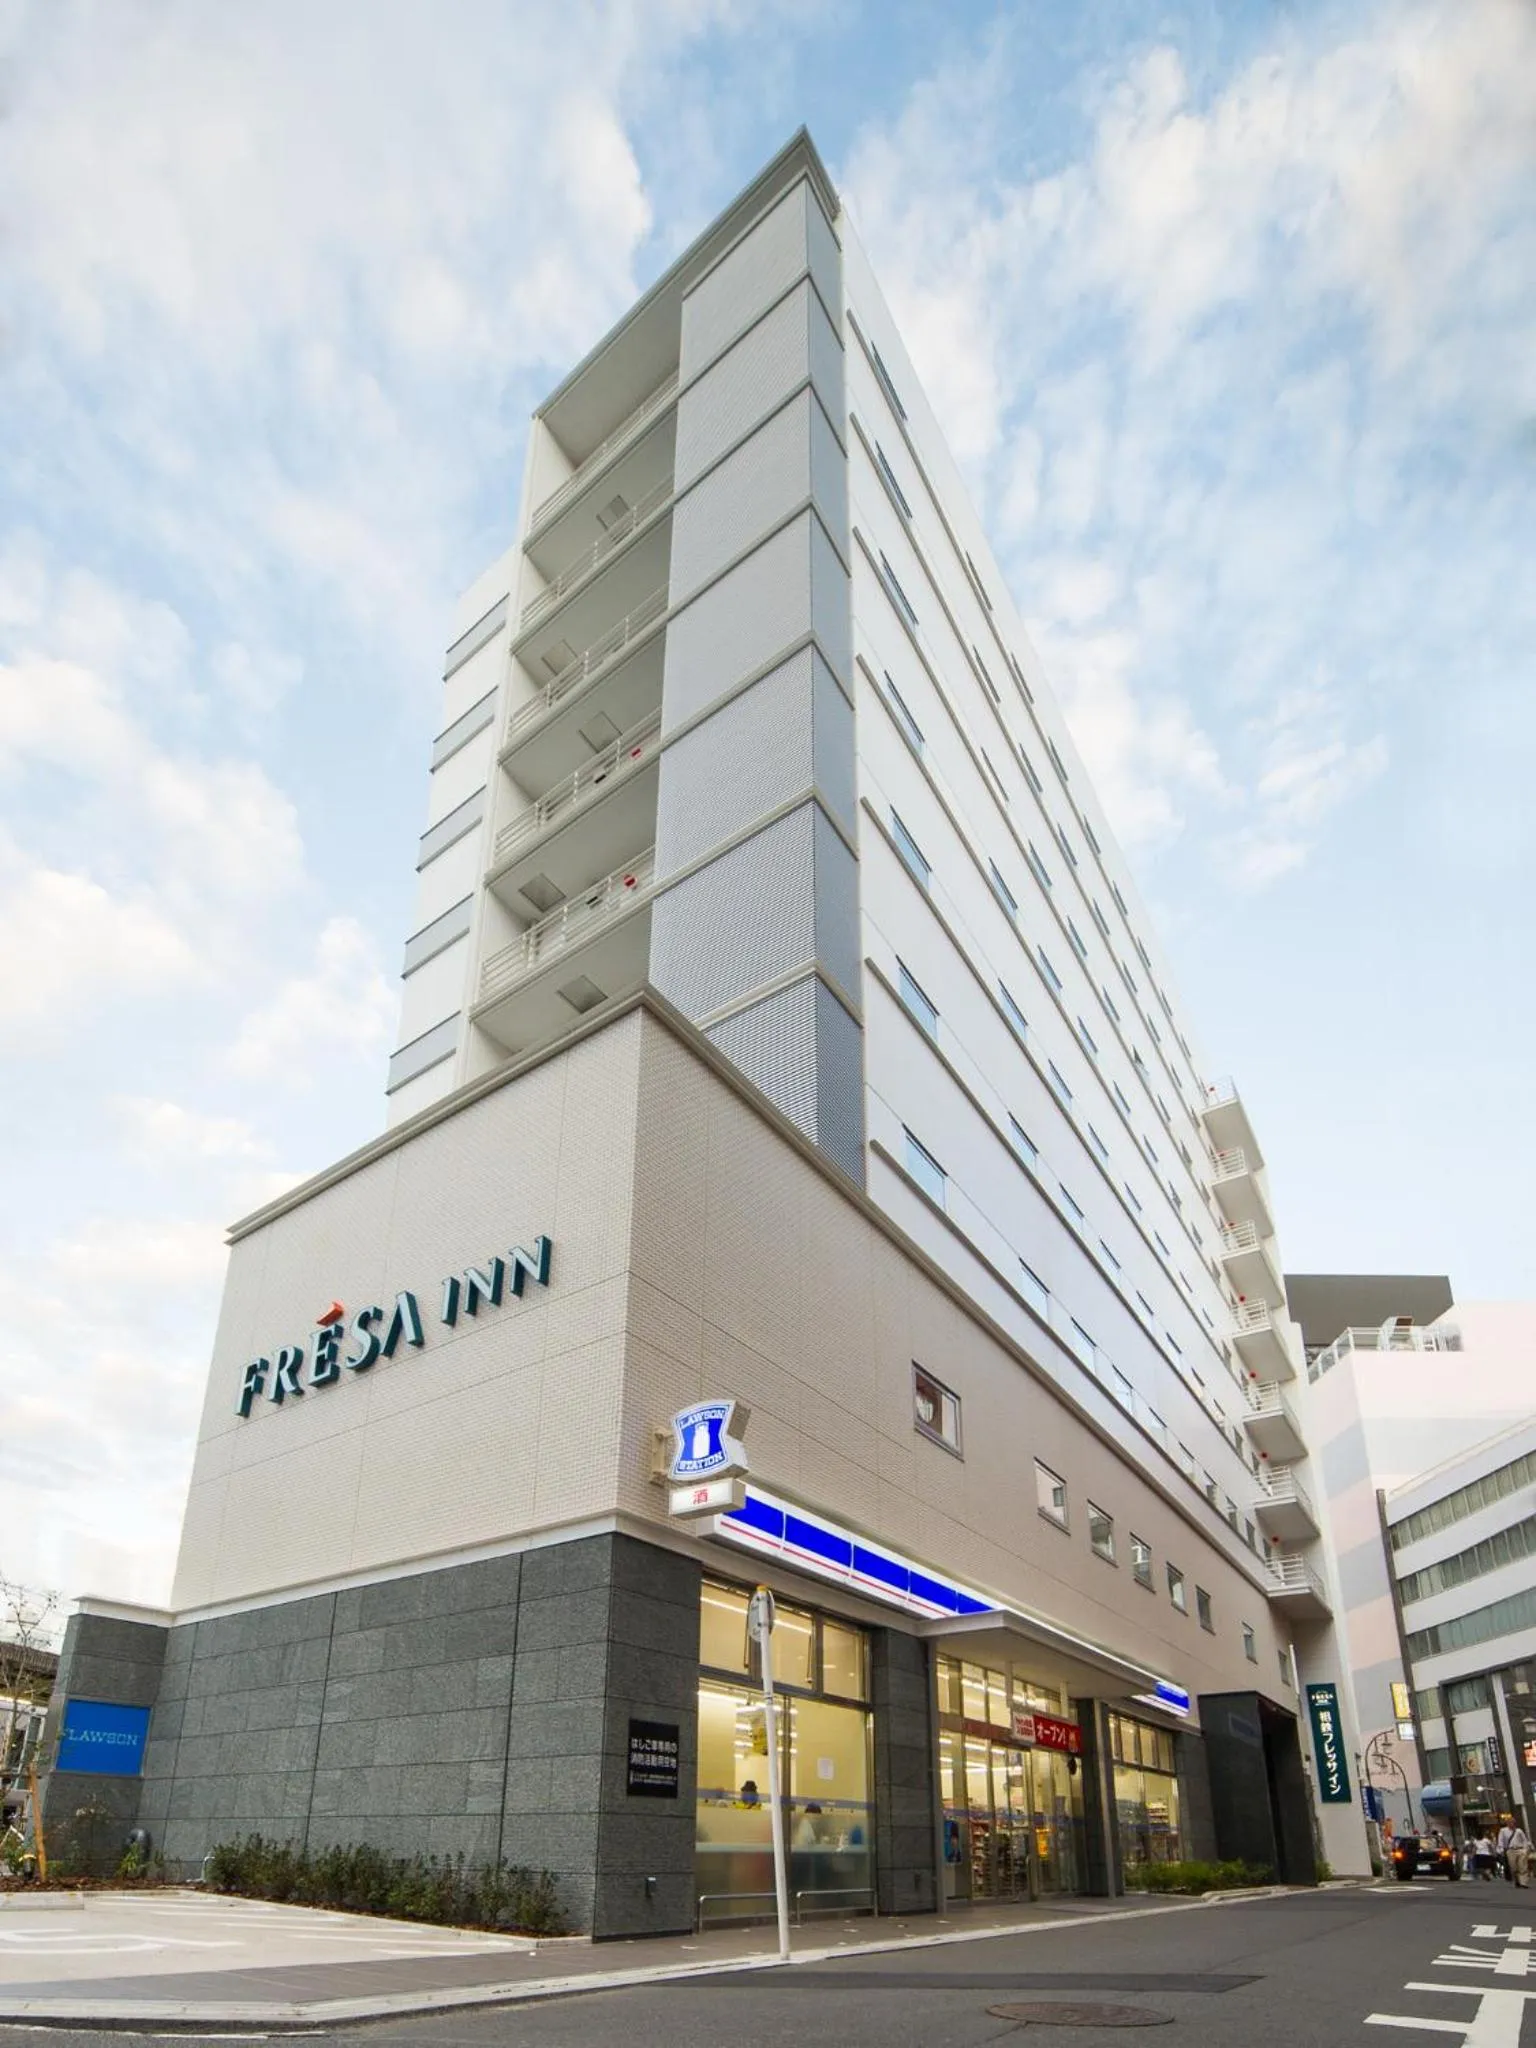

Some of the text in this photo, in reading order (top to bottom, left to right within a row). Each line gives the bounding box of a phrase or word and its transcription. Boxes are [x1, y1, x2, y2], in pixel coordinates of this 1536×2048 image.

[441, 1234, 552, 1327] INN
[679, 1409, 725, 1428] LAWSON
[678, 1452, 724, 1470] STATION
[692, 1488, 709, 1505] 酒
[67, 1728, 138, 1746] LAWSON
[1318, 1710, 1342, 1796] 相鉄フレッサイン
